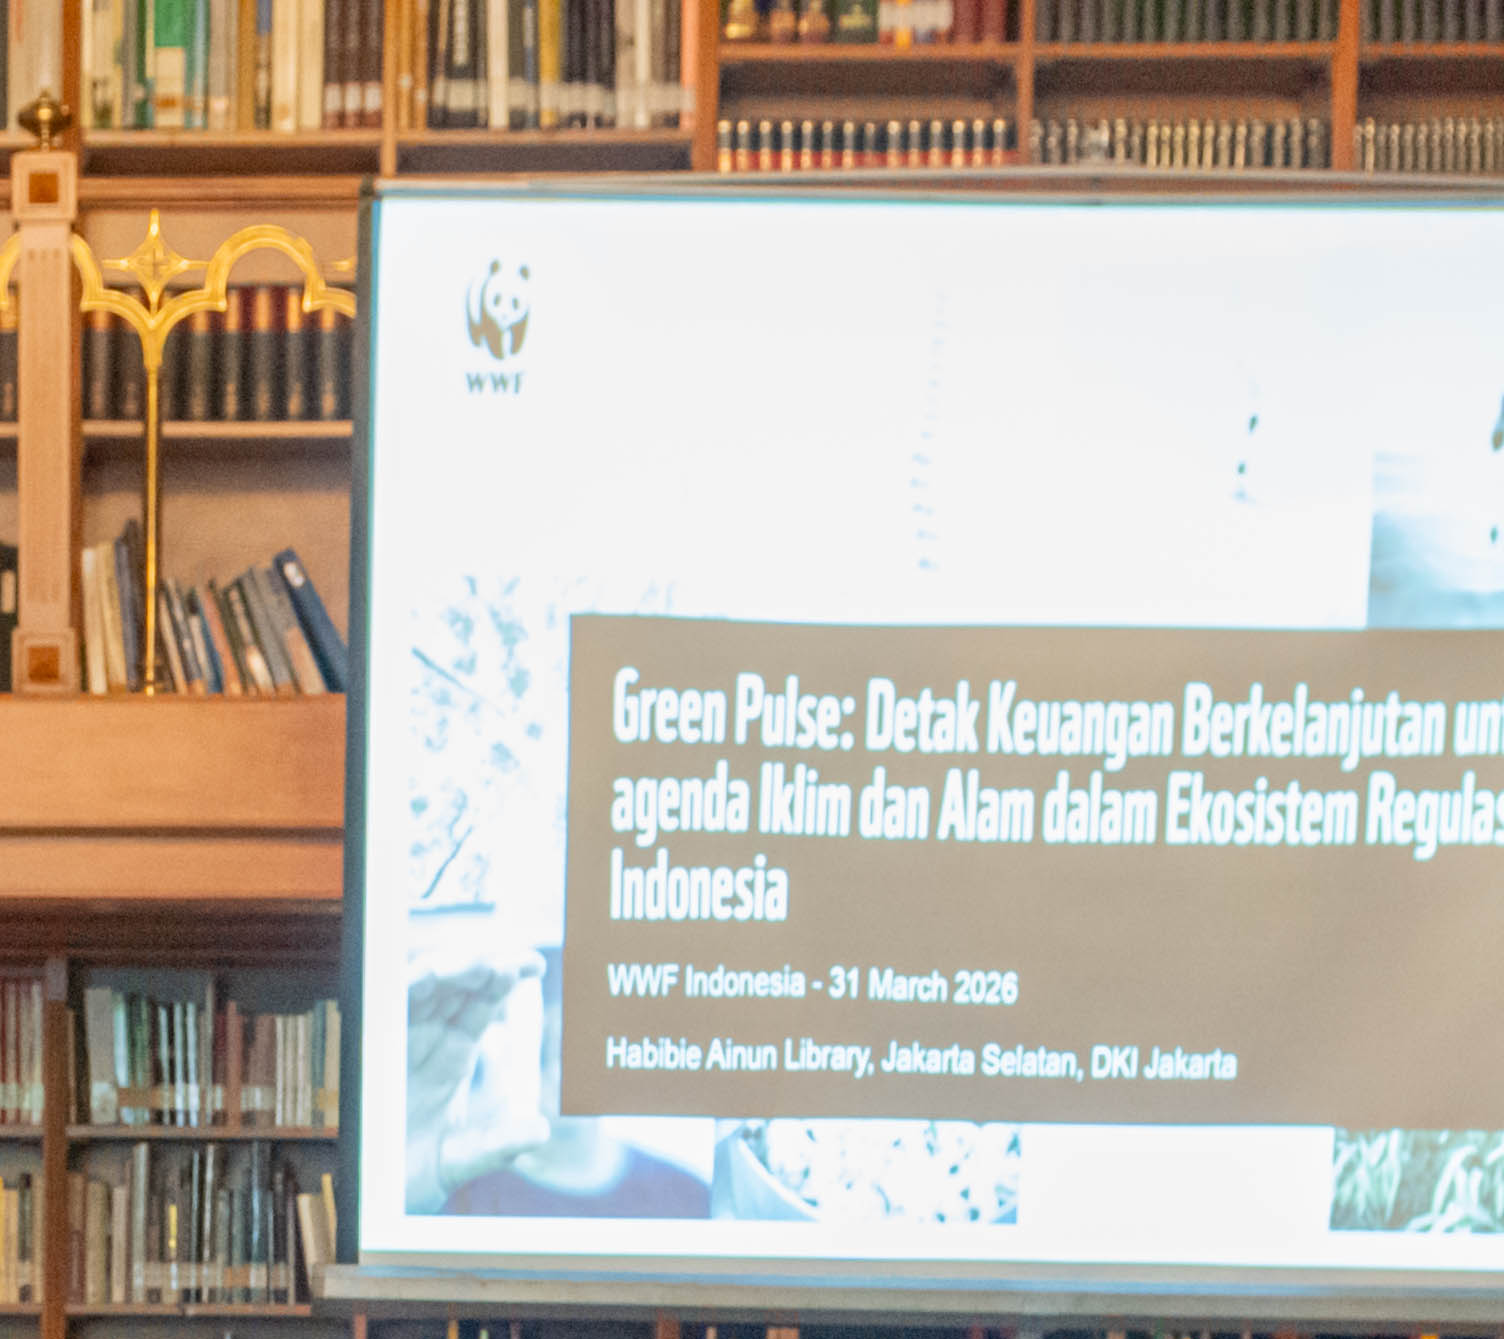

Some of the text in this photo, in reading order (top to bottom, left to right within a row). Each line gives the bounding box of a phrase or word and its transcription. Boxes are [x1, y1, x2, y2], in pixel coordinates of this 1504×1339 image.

[614, 667, 727, 744] Green
[735, 672, 856, 750] Pulse:
[866, 678, 980, 753] Detak
[987, 680, 1174, 771] Keuangan
[1182, 682, 1446, 771] Berkelanjutan
[611, 760, 750, 847] agenda
[759, 762, 851, 836] Iklim
[859, 766, 930, 840] dan
[936, 768, 1034, 842] Alam
[1043, 770, 1157, 844] dalam
[1166, 771, 1358, 846] Ekosistem
[611, 847, 789, 921] Indonesia
[608, 963, 680, 996] WWF
[686, 964, 805, 997] Indonesia
[829, 966, 859, 998] 31
[868, 967, 948, 1002] March
[954, 970, 1018, 1005] 2026
[607, 1036, 1237, 1082] Habibie Ainun Library, Jakarta Selatan, DKI Jakarta
